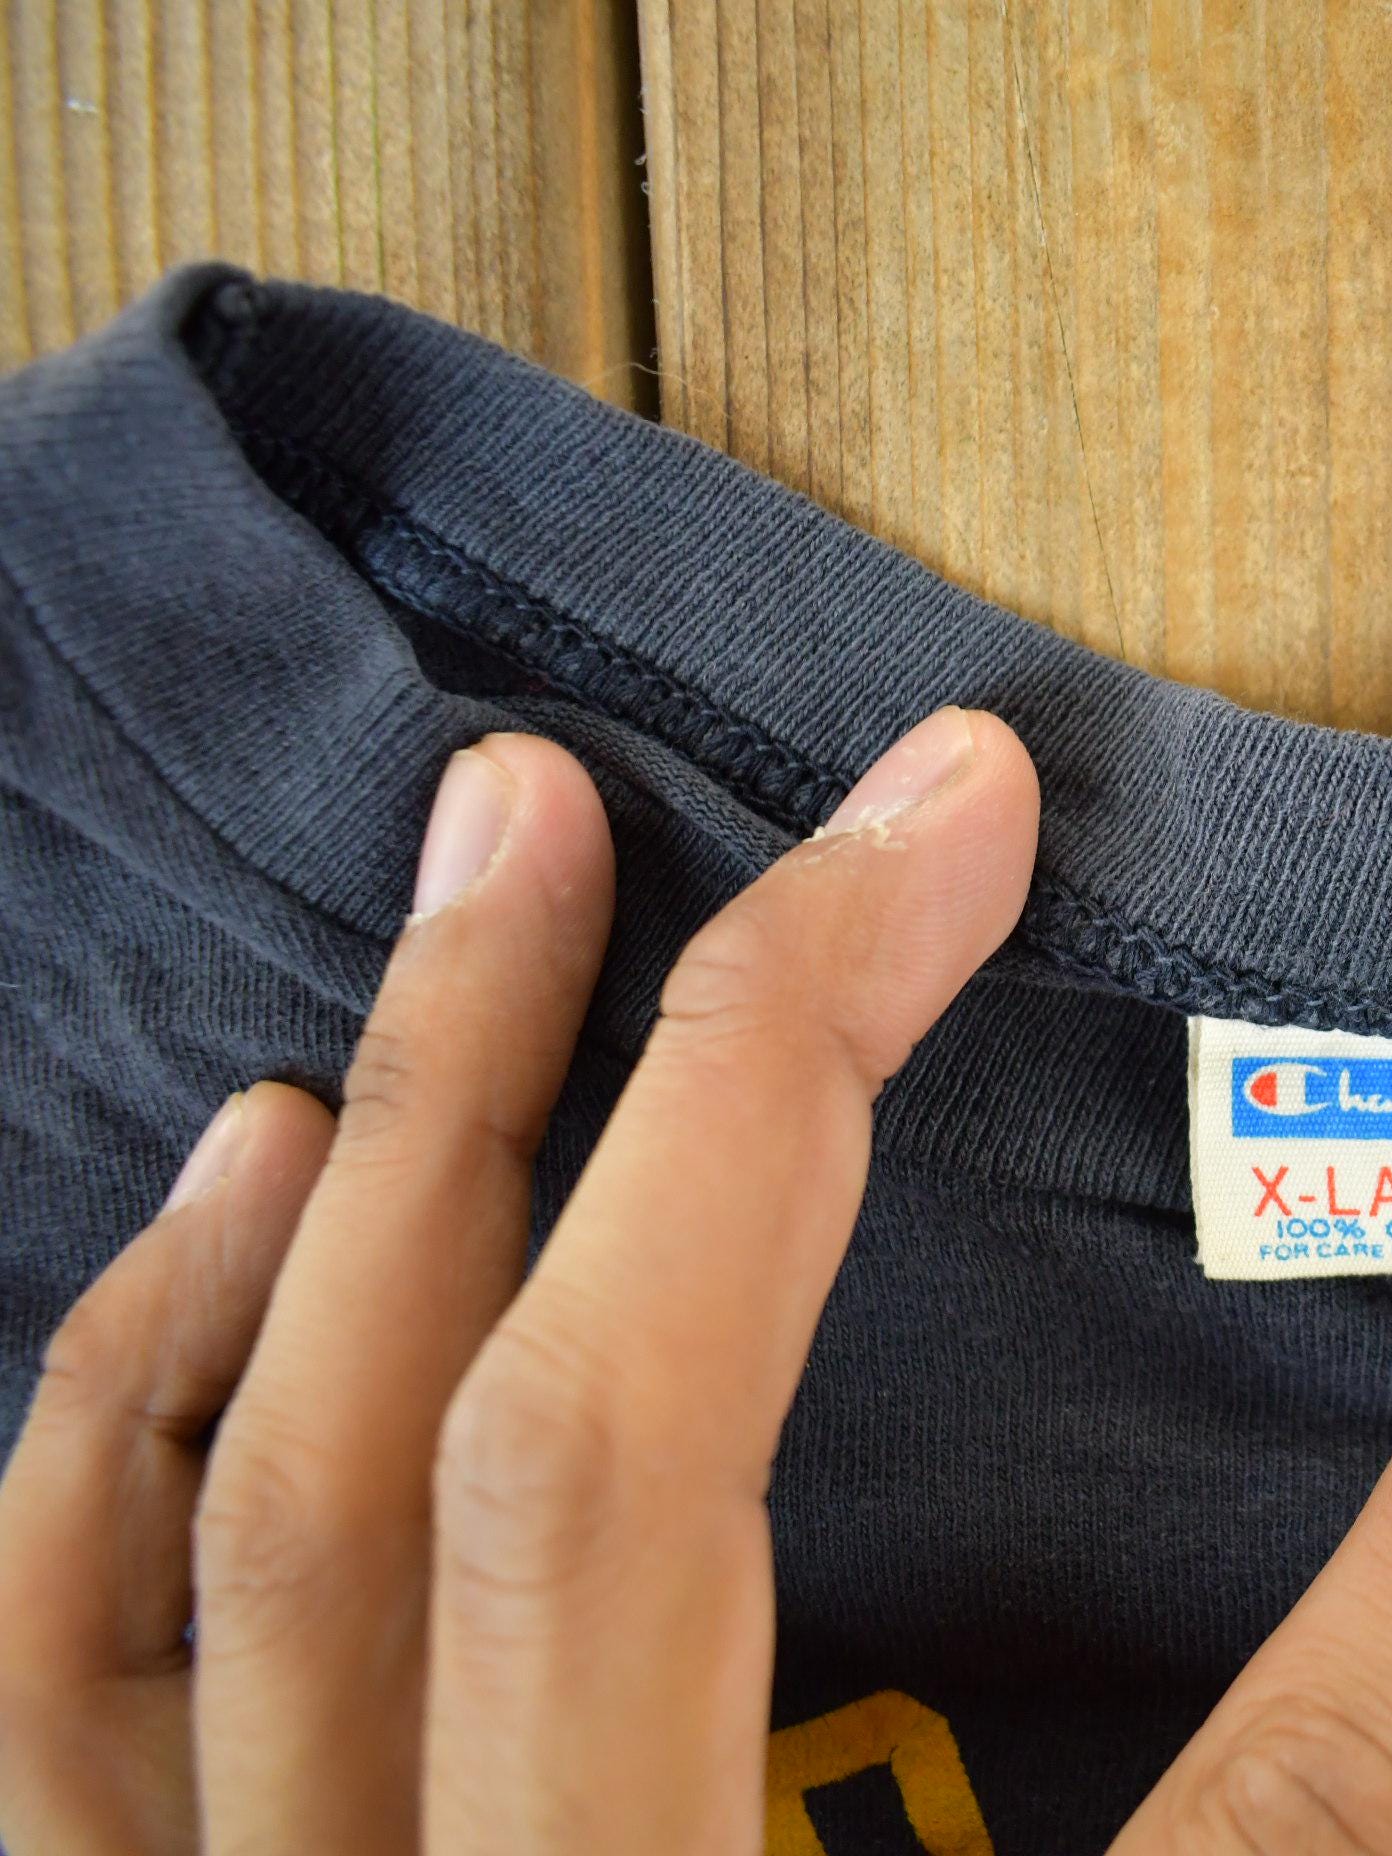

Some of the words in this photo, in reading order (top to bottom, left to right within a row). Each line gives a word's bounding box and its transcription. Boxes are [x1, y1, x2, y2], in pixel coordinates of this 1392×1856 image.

[1276, 1217, 1366, 1239] 100%
[1259, 1243, 1310, 1261] FOR
[1316, 1242, 1385, 1259] CARE
